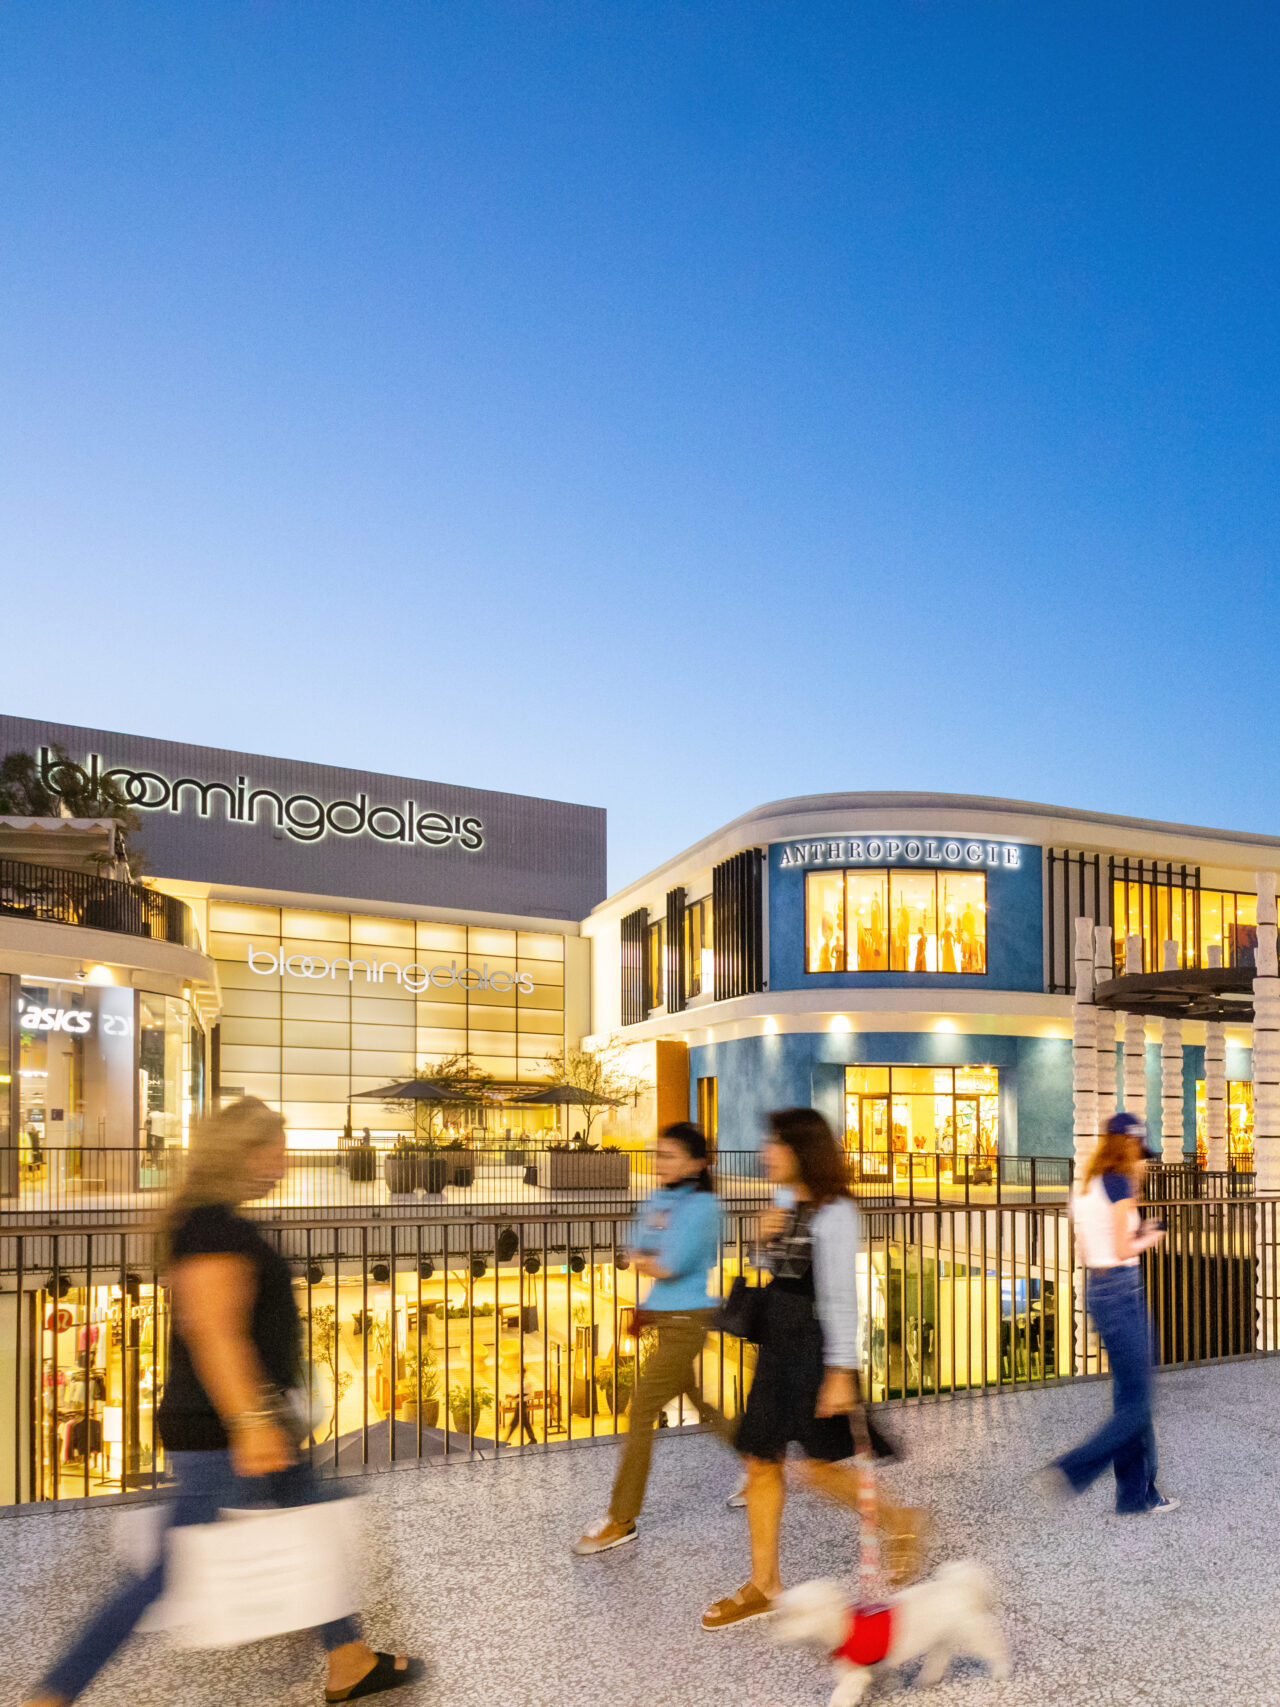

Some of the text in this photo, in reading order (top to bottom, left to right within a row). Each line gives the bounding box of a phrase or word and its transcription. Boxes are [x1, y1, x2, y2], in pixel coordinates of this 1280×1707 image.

[40, 746, 484, 850] bloomingdale's
[780, 841, 1020, 866] ANTHROPOLOGIE
[248, 943, 534, 994] bloomingdale's
[20, 1006, 92, 1033] asics
